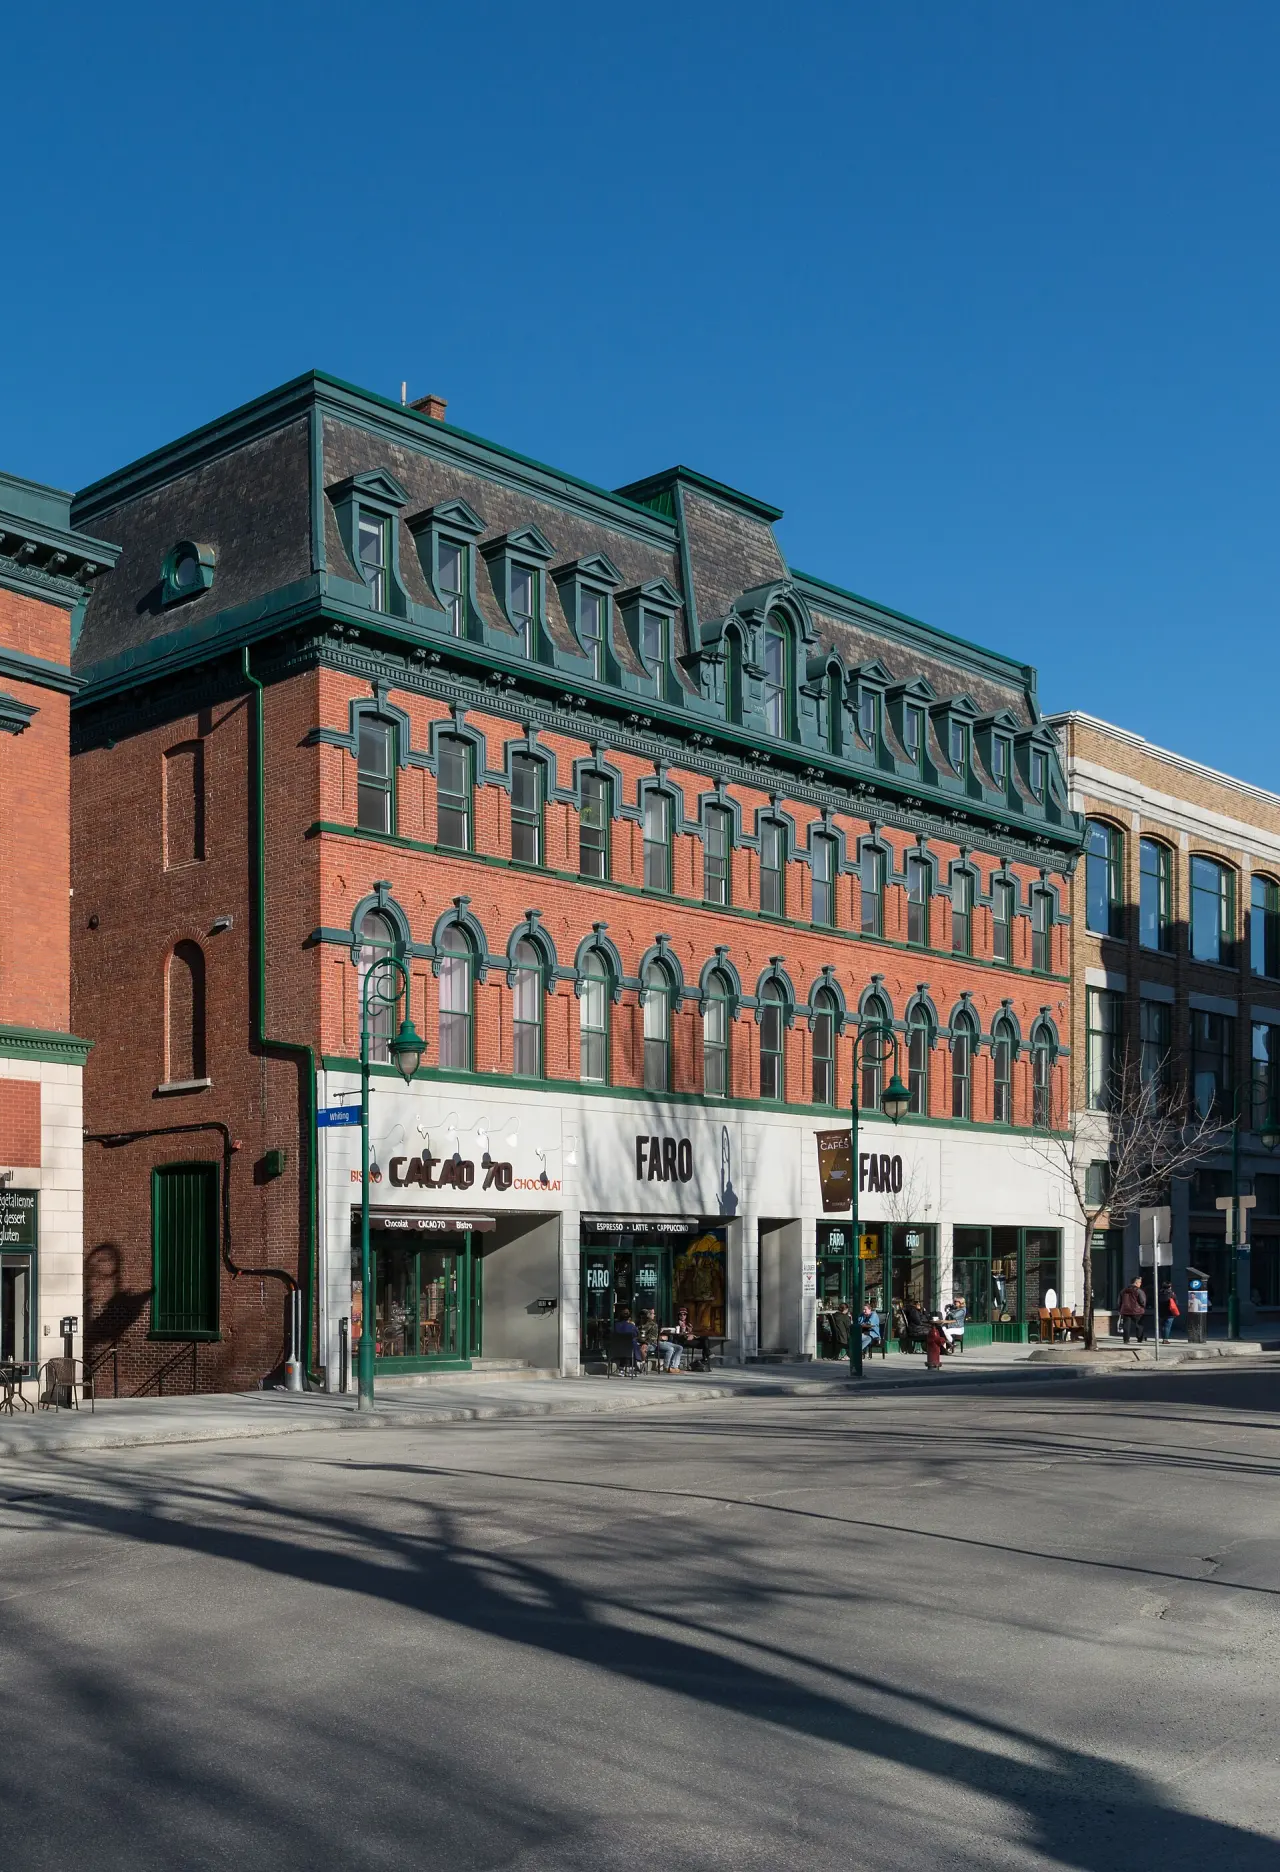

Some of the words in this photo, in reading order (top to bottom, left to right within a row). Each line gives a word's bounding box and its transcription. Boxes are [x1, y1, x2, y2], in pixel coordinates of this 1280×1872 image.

[329, 1112, 350, 1121] Whiting
[820, 1139, 849, 1151] CAFÉS
[636, 1135, 693, 1183] FARO
[388, 1156, 475, 1190] CACAO
[481, 1161, 513, 1191] 70
[859, 1152, 903, 1193] FARO
[513, 1178, 562, 1191] CHOCOLAT
[4, 1209, 26, 1225] dessert
[384, 1219, 409, 1228] Chocolat
[456, 1221, 473, 1230] Bistro
[596, 1223, 624, 1231] ESPRESSO
[632, 1223, 649, 1231] LATTE
[657, 1224, 689, 1232] CAPPUCCINO
[0, 1225, 20, 1246] gluten
[829, 1232, 845, 1246] FARO
[905, 1234, 920, 1248] FARO
[586, 1269, 610, 1288] FARO
[639, 1269, 657, 1287] FAR
